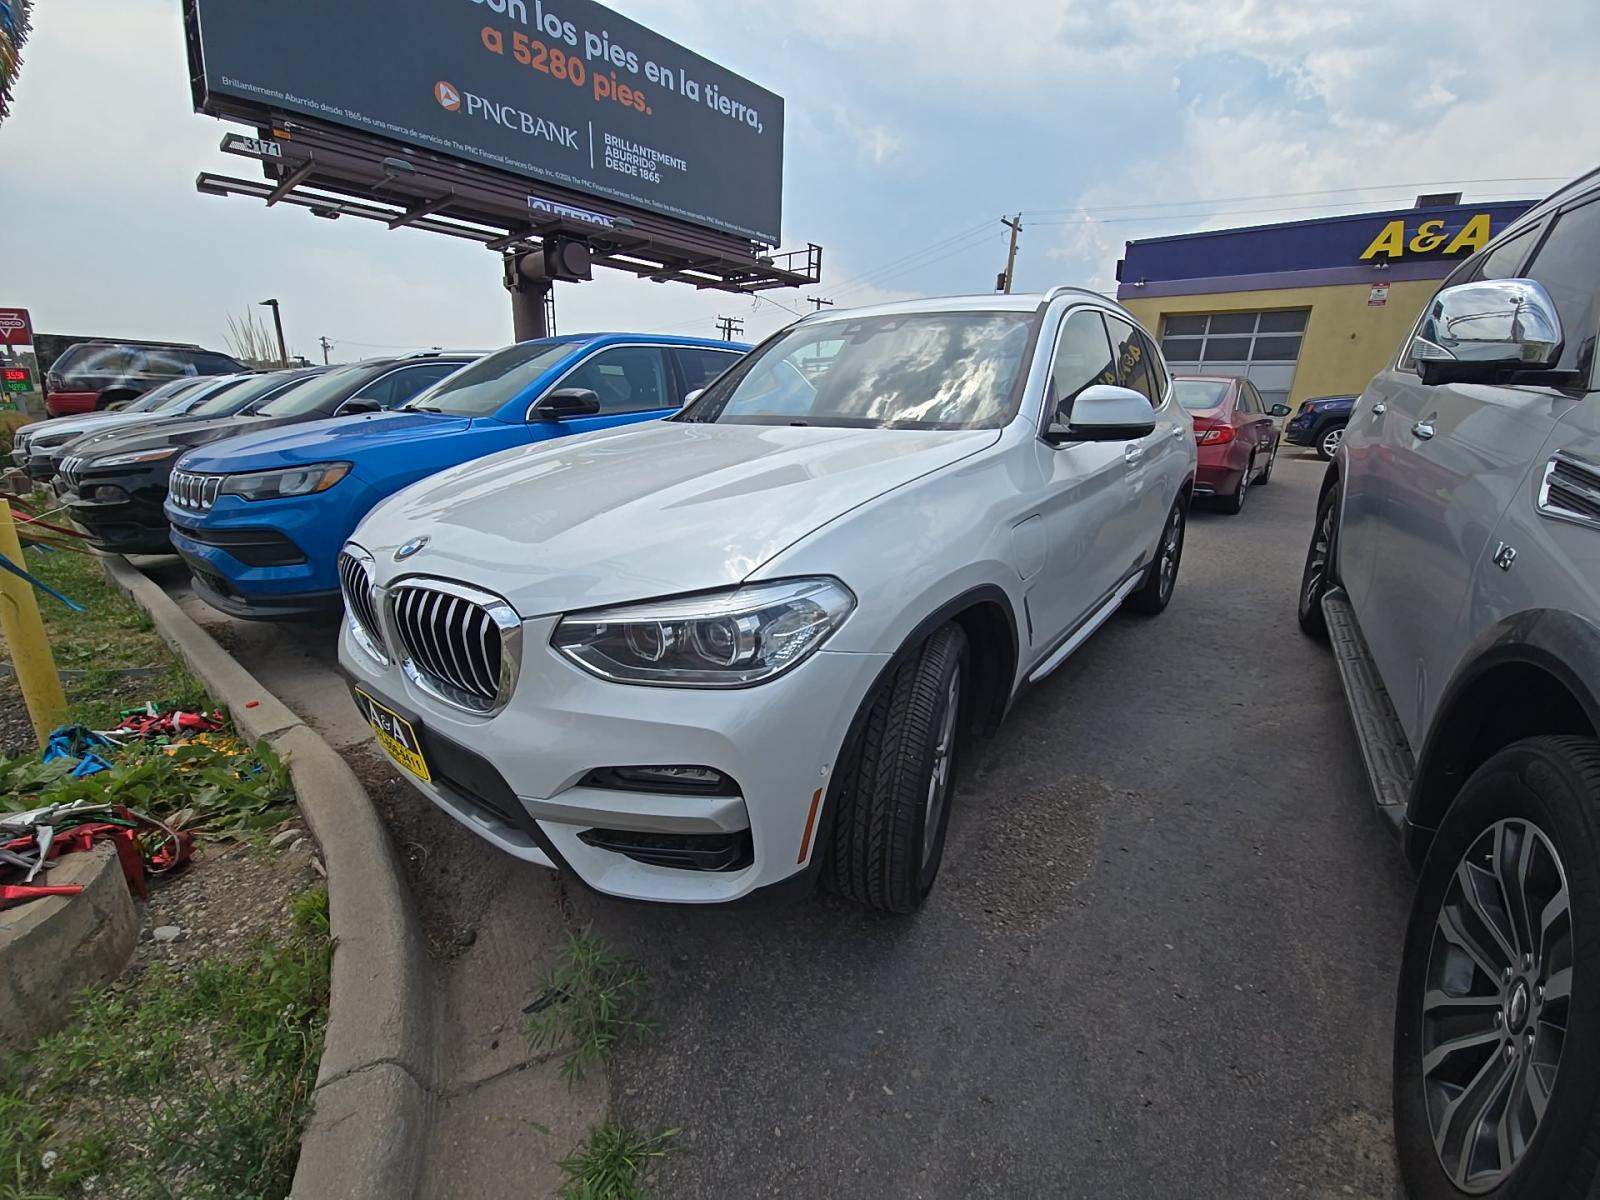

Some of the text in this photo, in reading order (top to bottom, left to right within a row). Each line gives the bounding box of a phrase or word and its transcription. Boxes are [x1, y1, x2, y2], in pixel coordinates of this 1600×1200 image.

[481, 26, 653, 116] a 5280 pies.
[535, 0, 577, 46] los
[585, 30, 639, 74] pies
[644, 61, 674, 91] en
[680, 69, 699, 102] la
[705, 83, 763, 133] tierra,
[221, 76, 284, 99] Brillantemente
[285, 92, 319, 109] Aburrido
[246, 139, 280, 156] 3171
[604, 132, 688, 172] BRILLANTEMENTE
[605, 145, 656, 171] ABURRIDO
[605, 156, 661, 184] DESDE 1865
[1359, 213, 1491, 259] A&A
